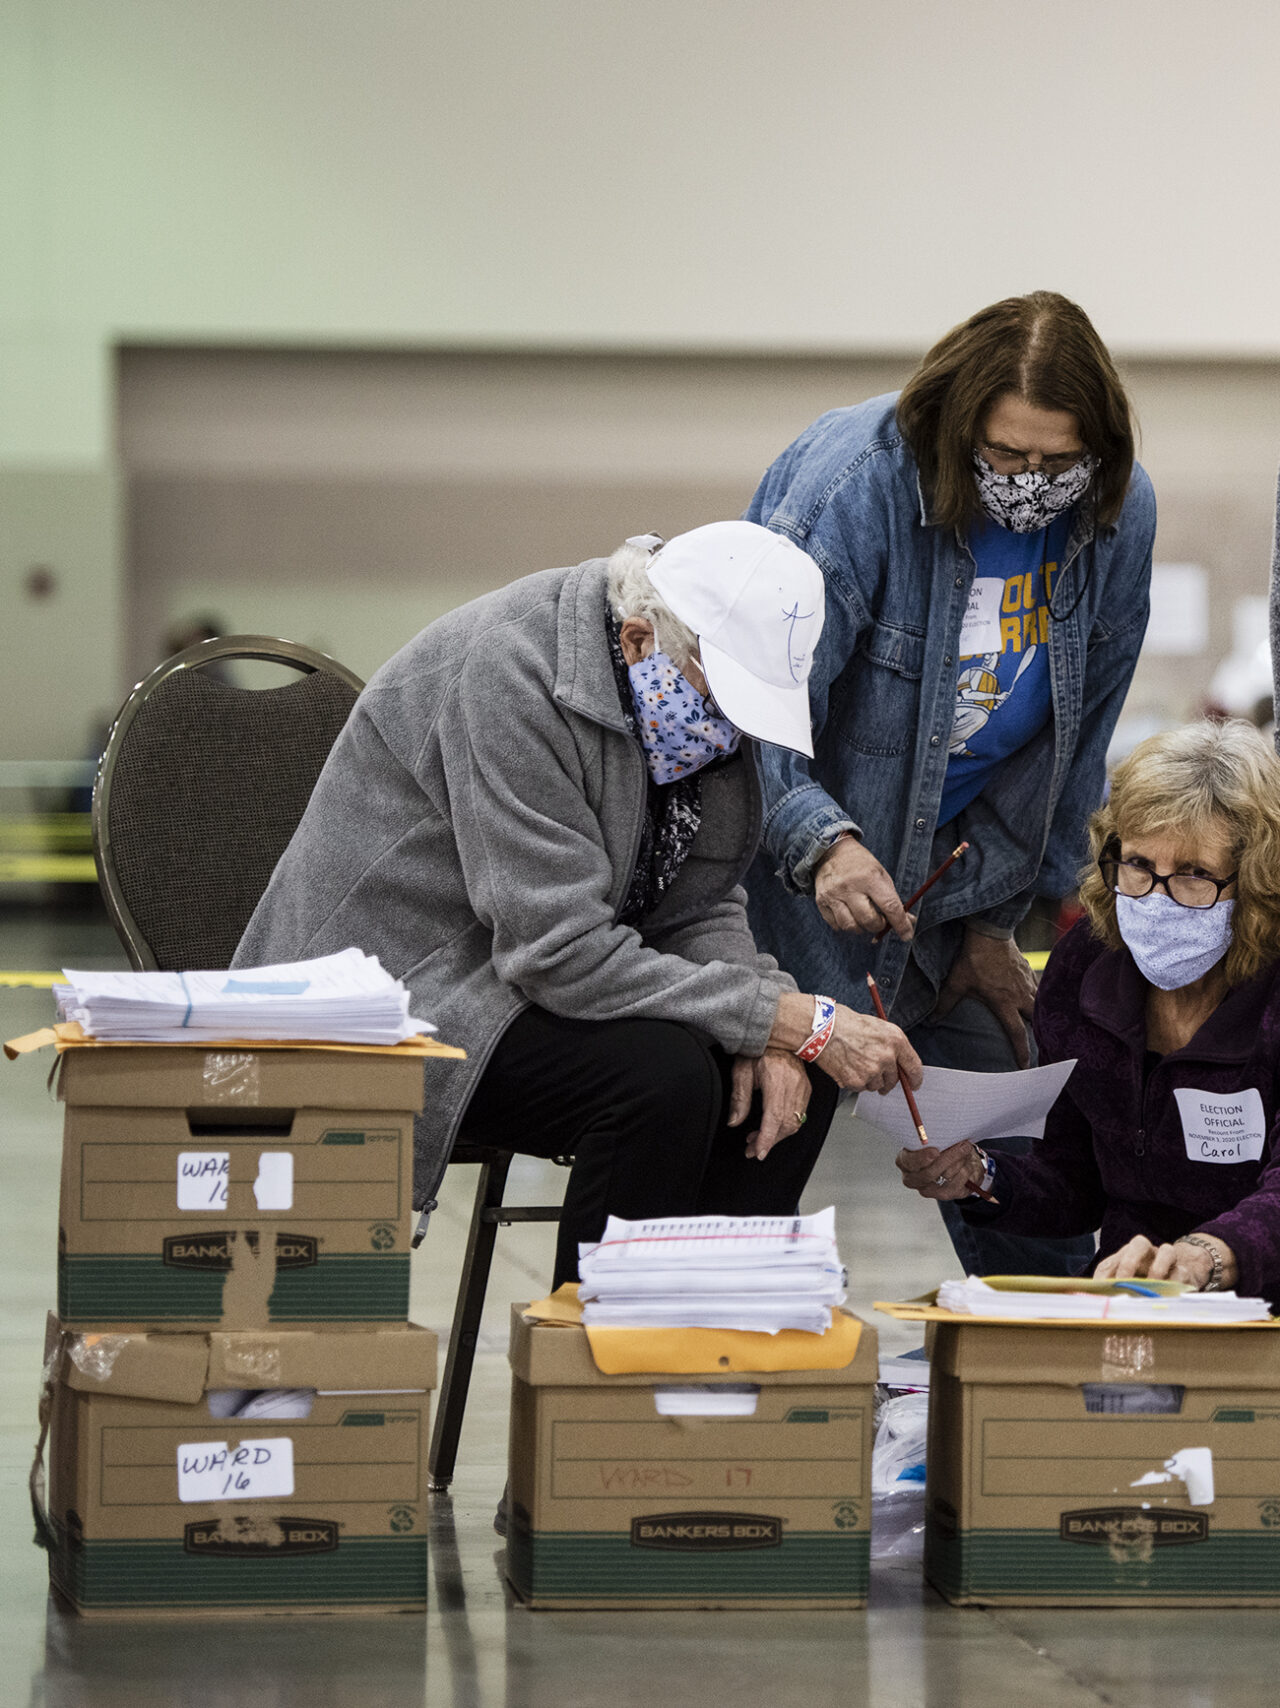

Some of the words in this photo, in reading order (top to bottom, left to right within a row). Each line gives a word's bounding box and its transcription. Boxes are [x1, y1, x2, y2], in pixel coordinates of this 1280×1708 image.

[1200, 1103, 1243, 1115] ELECTION
[1204, 1117, 1245, 1128] OFFICIAL
[1201, 1141, 1241, 1157] Carol
[183, 1447, 272, 1474] WARD
[221, 1471, 251, 1495] 16
[725, 1467, 752, 1487] 17
[640, 1524, 730, 1539] BANKERS
[733, 1525, 775, 1538] BOX
[1160, 1520, 1200, 1533] BOX
[288, 1530, 329, 1543] BOX
